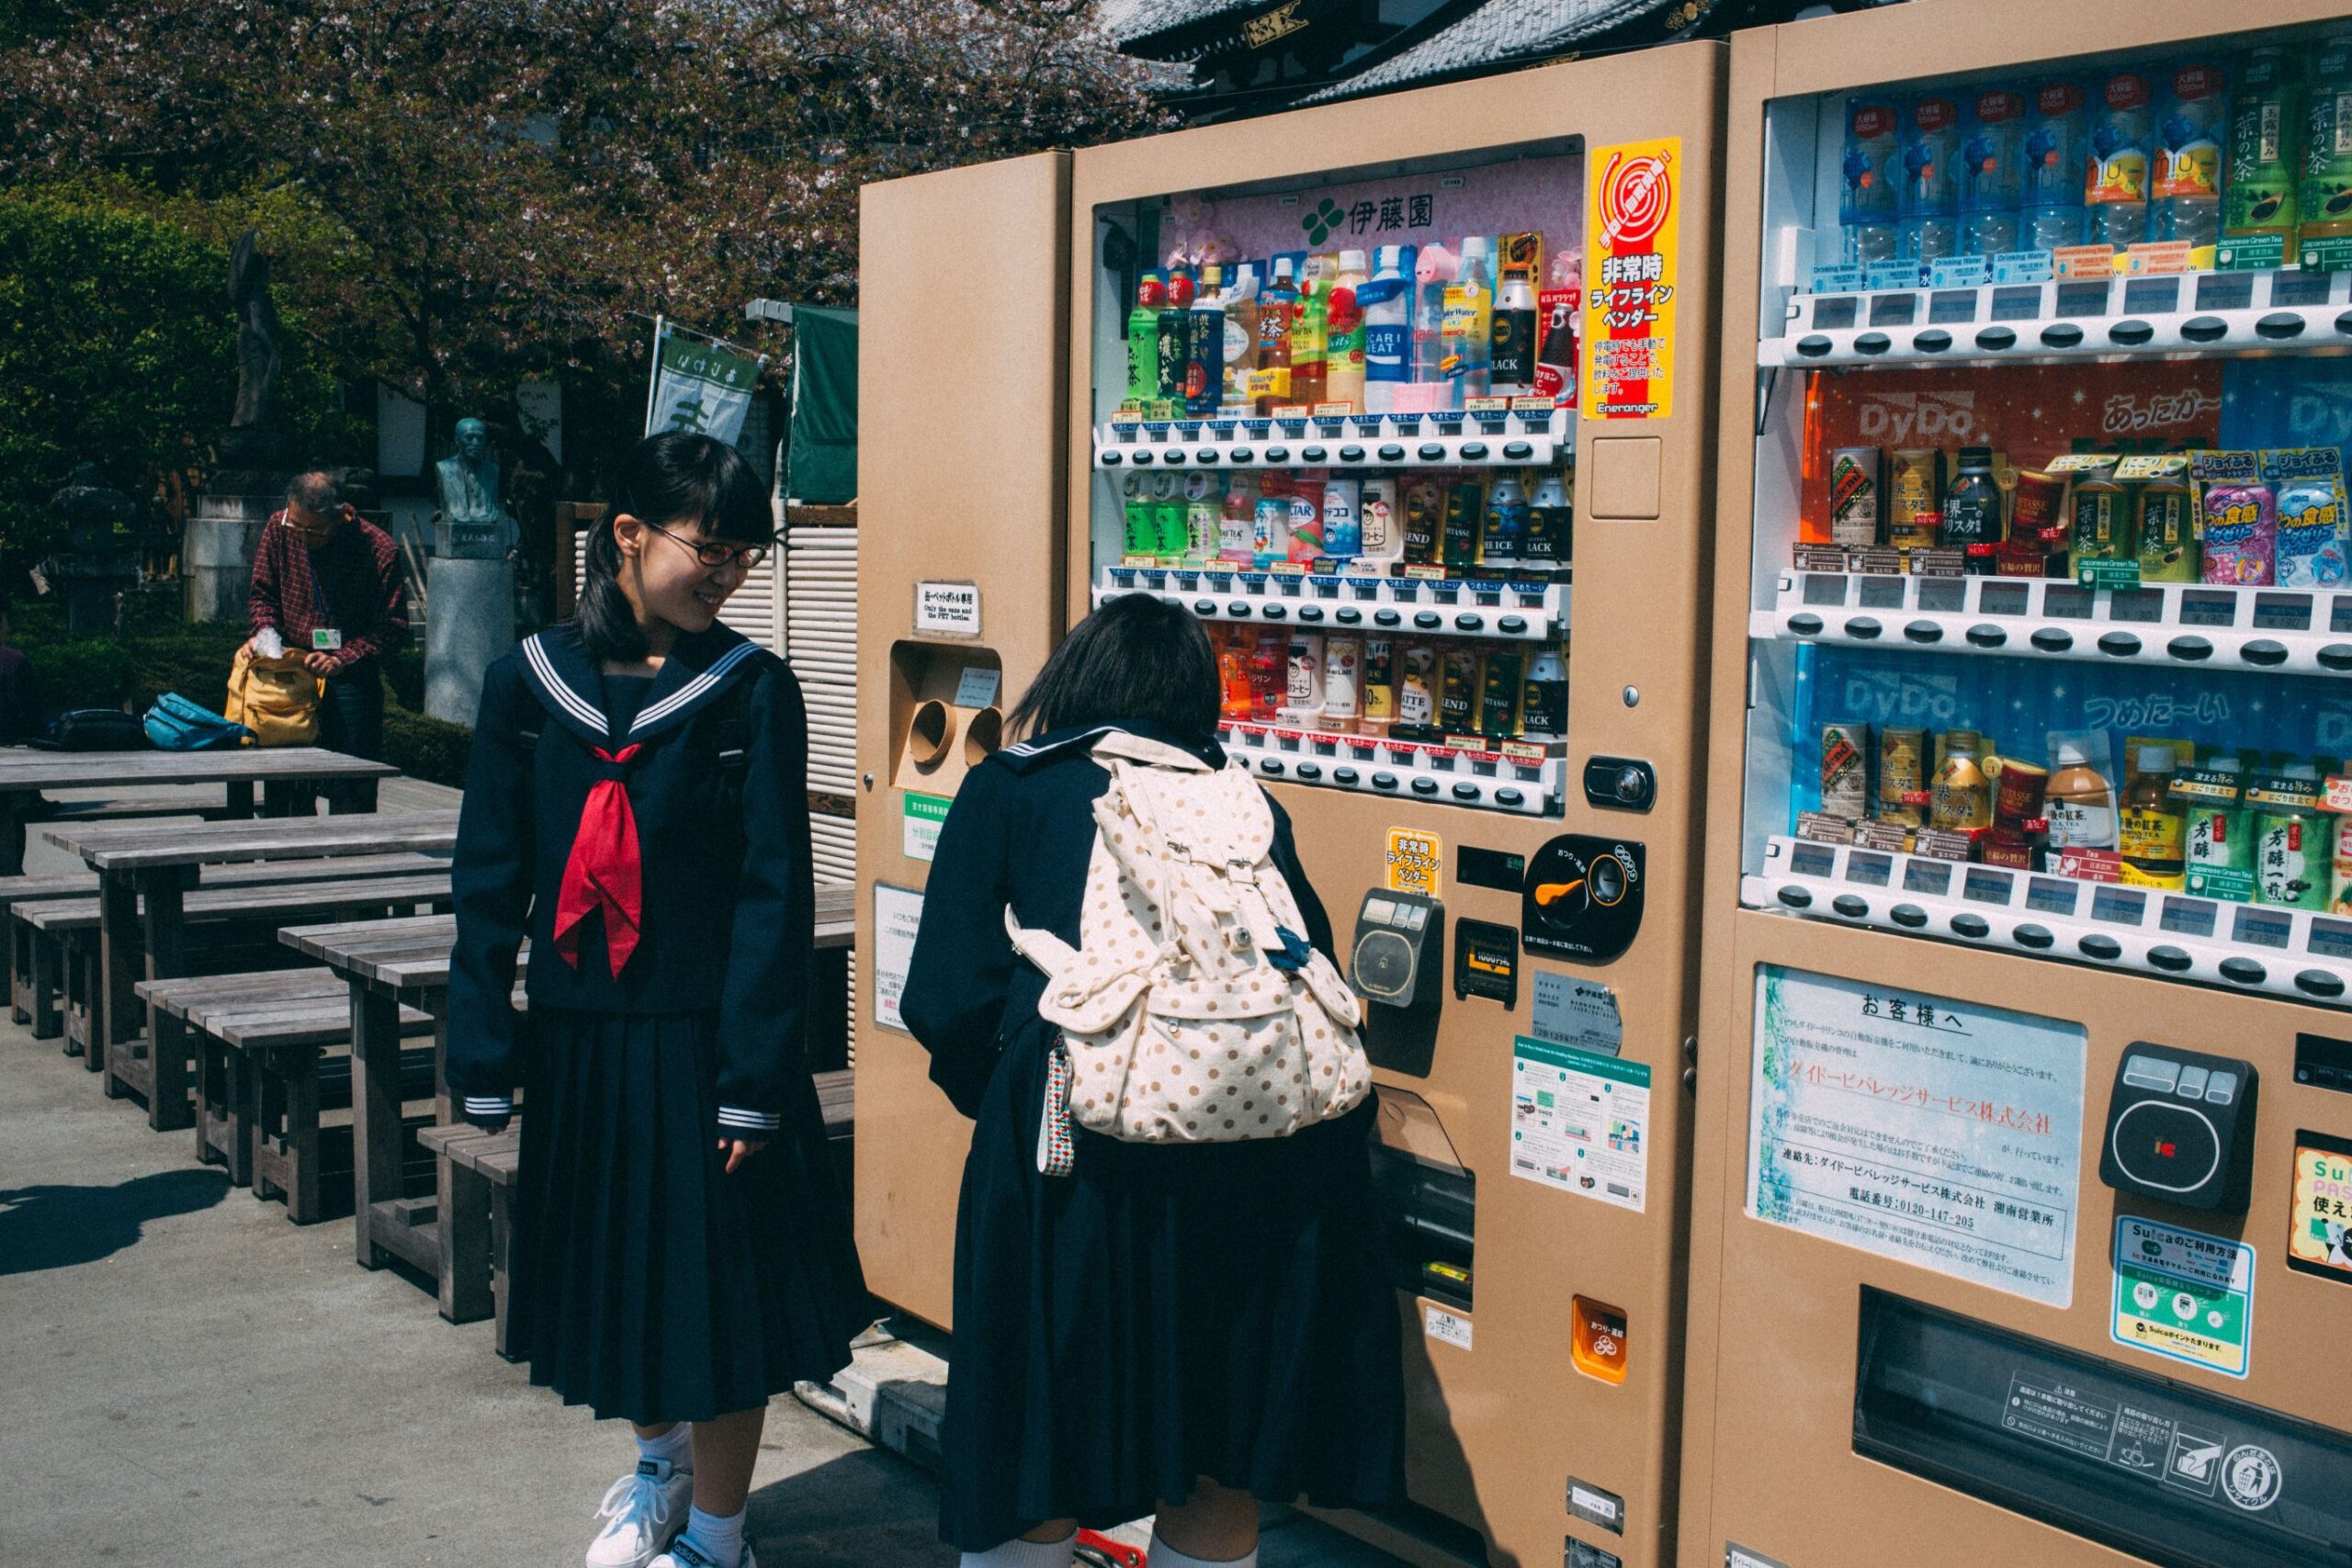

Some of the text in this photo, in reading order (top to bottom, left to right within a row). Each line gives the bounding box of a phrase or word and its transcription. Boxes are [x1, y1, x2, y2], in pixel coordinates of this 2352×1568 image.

[2234, 111, 2258, 183] 葉の茶
[2307, 102, 2333, 175] 葉の茶
[1348, 194, 1433, 235] 伊藤園
[2251, 236, 2271, 244] Green
[2302, 240, 2335, 248] Japanese
[1602, 254, 1663, 285] 非常時
[1591, 285, 1674, 309] ライフライン
[1602, 309, 1658, 329] ベンダー
[1536, 379, 1543, 388] C
[1593, 382, 1623, 395] します。
[1597, 402, 1657, 414] Eneranger
[1860, 395, 1974, 443] DyDo
[2202, 452, 2256, 470] ジョイふる
[2278, 449, 2338, 469] ジョイふる
[1917, 516, 1937, 525] NEW
[2078, 505, 2094, 555] 葉の茶
[2146, 506, 2161, 555] 葉の茶
[1495, 540, 1514, 550] ICE
[2079, 558, 2109, 569] Japanese
[2109, 559, 2126, 568] Green
[1844, 675, 1957, 721] DyDo
[2085, 693, 2230, 730] つめた〜い
[2194, 772, 2235, 784] 深まる旨み
[2270, 780, 2313, 793] 深まる旨み
[1905, 795, 1924, 803] NEW
[2190, 784, 2233, 796] にごり仕立て
[2267, 793, 2311, 806] にごり仕立て
[1800, 811, 1817, 820] Coffee
[1857, 819, 1876, 829] Coffee
[1918, 827, 1938, 836] Coffee
[2193, 818, 2212, 859] 芳醇
[1397, 839, 1430, 856] 非常時
[2086, 850, 2098, 858] Tea
[1386, 852, 1441, 871] ライフライン
[2190, 863, 2253, 879] Japanese Green Tea
[2266, 827, 2287, 902] 芳醇一煎
[1397, 870, 1429, 883] ベンダー
[1862, 993, 1963, 1028] お客様へ
[1790, 1059, 2052, 1134] ダイドービバレッジサービス株式会社
[2313, 1160, 2352, 1185] Su
[2312, 1179, 2352, 1201] PAS
[1849, 1186, 1975, 1229] 電話番号:0120-147-205
[1994, 1201, 2055, 1227] 湘南営業所
[2312, 1196, 2352, 1218] 使え
[2132, 1224, 2238, 1261] Suicaのご利用方法
[2226, 1483, 2269, 1507] リサイクル
